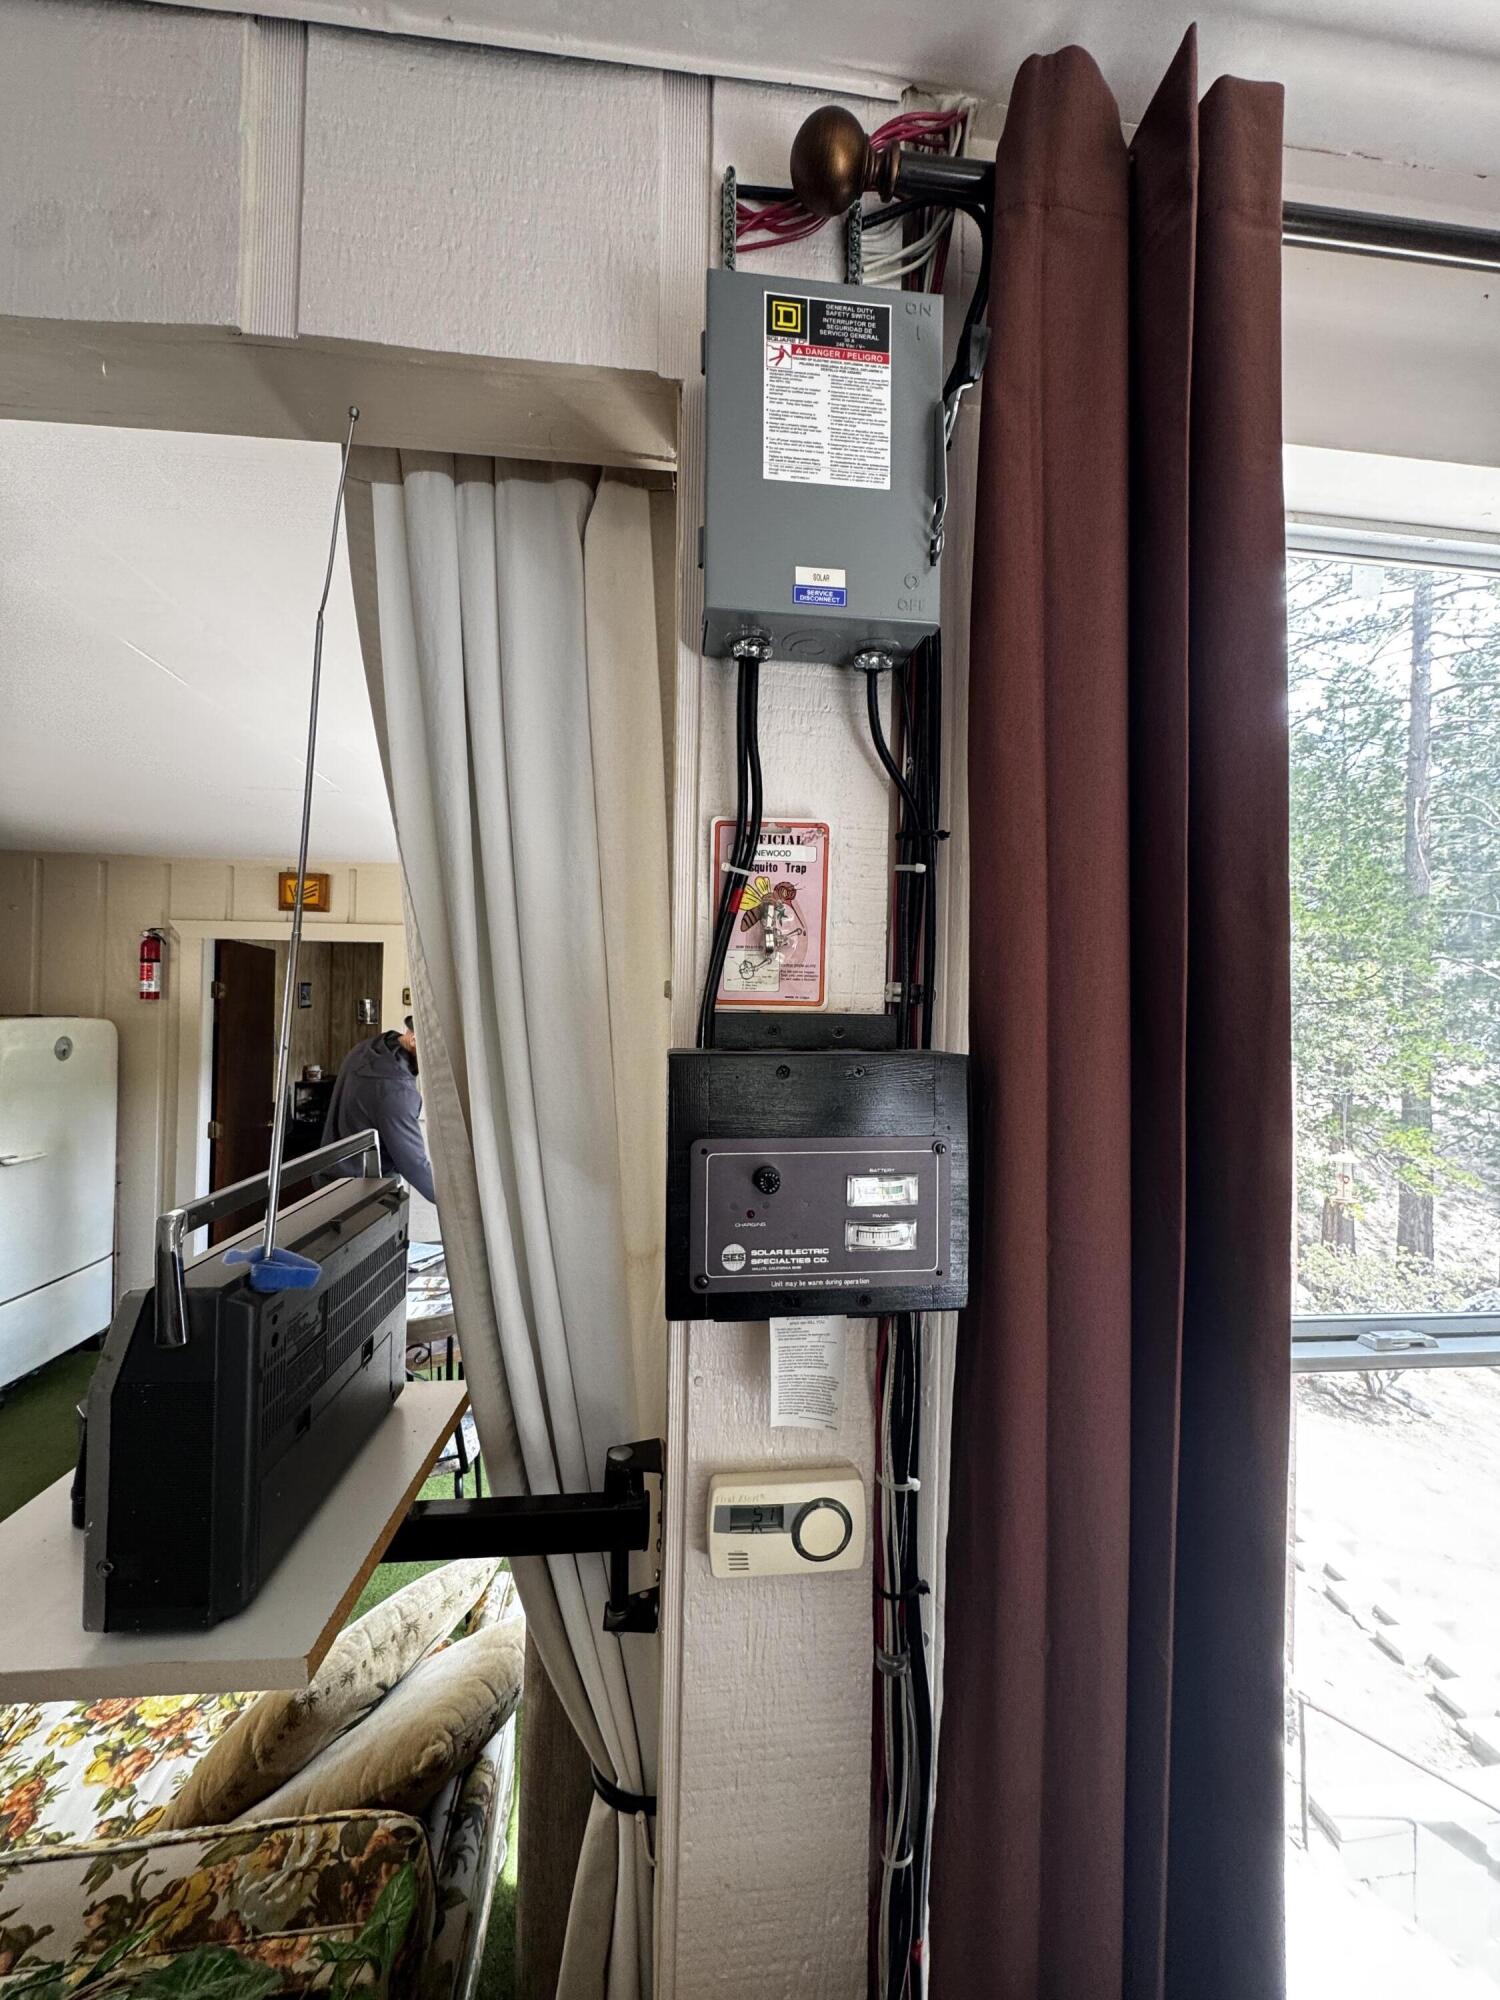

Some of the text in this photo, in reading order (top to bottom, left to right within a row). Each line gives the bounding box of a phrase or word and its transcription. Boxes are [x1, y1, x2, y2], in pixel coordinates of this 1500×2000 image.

[825, 304, 855, 313] GENERAL
[905, 302, 931, 317] ON
[825, 310, 876, 321] SAFETY SWITCH
[822, 317, 867, 327] INTERRUPTOR
[826, 324, 862, 333] SEGURIDAD
[820, 329, 880, 341] SERVICIO GENERAL
[805, 348, 841, 358] DANGER
[847, 351, 883, 362] PELIGRO
[812, 573, 830, 582] SOLAR
[807, 589, 833, 597] SERVICE
[800, 595, 840, 603] DISCONNECT
[785, 862, 807, 874] Trap
[722, 1253, 746, 1261] SES
[751, 1257, 811, 1265] SPECIALTIES
[825, 1279, 842, 1287] during
[843, 1279, 870, 1287] operation
